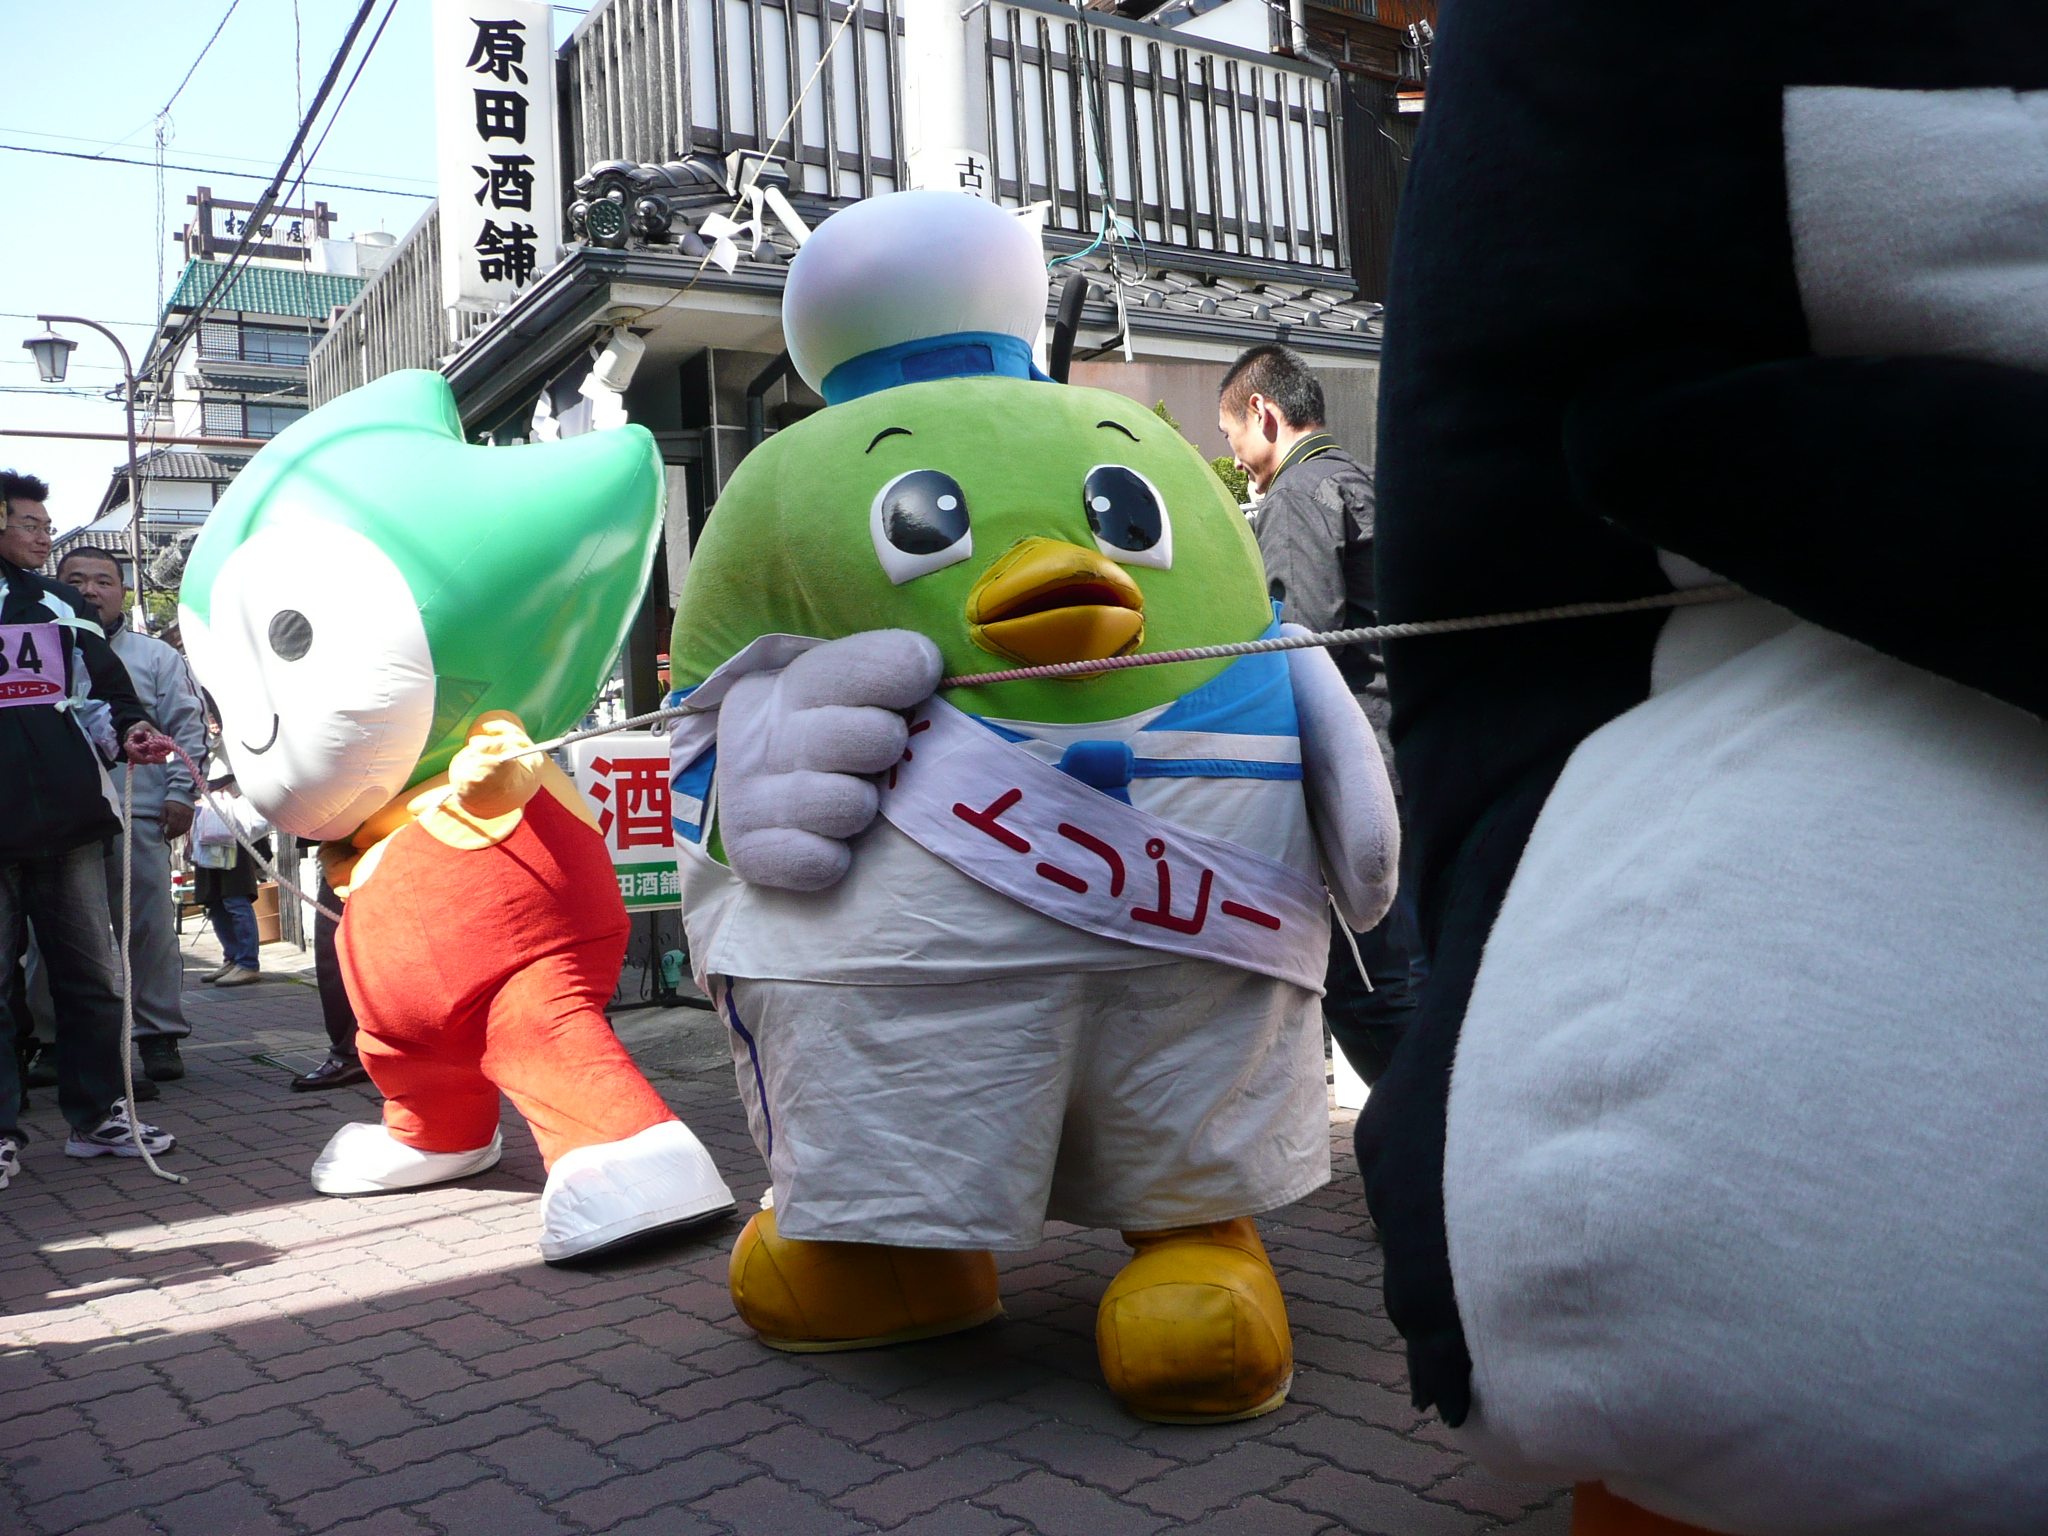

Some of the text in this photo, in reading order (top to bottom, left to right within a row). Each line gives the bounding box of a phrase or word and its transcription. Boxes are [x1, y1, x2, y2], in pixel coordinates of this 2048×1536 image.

[465, 16, 538, 288] 原田酒舗
[955, 156, 984, 197] 古
[588, 756, 675, 850] 酒
[952, 788, 1281, 935] トリピー
